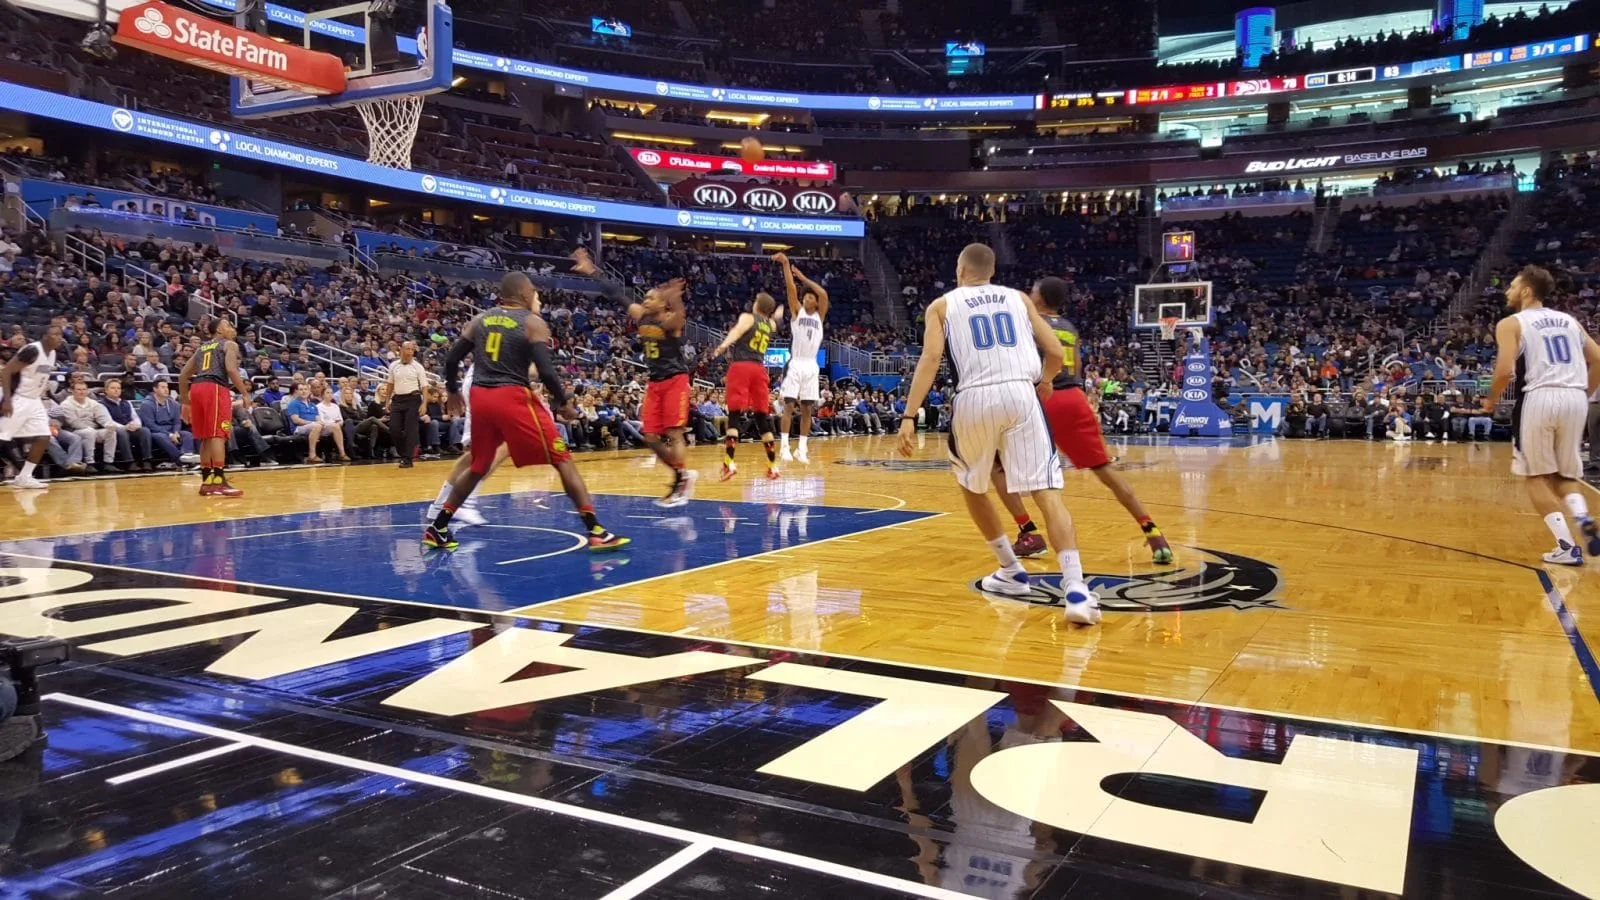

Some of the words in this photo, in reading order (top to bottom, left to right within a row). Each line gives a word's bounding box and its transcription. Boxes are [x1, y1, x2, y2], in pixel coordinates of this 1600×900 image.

[271, 9, 293, 22] LOCAL
[327, 23, 355, 37] EXPERTS
[1532, 43, 1554, 56] 3/1
[514, 64, 533, 74] LOCAL
[1206, 86, 1214, 96] 2
[137, 117, 198, 135] INTERNATIONAL
[137, 125, 174, 139] DIAMOND
[235, 140, 263, 155] LOCAL
[264, 146, 304, 163] DIAMOND
[305, 155, 338, 170] EXPERTS
[1344, 150, 1400, 164] BASELINE
[1401, 147, 1427, 159] BAR
[510, 194, 533, 205] LOCAL
[534, 198, 567, 209] DIAMOND
[567, 202, 596, 213] EXPERTS
[700, 189, 730, 205] KIA
[750, 191, 779, 207] KIA
[800, 194, 829, 210] KIA
[760, 221, 781, 229] LOCAL
[782, 222, 814, 231] DIAMOND
[815, 223, 842, 232] EXPERTS
[1180, 243, 1189, 258] 7
[964, 294, 1007, 309] GORDON
[806, 328, 814, 341] 4
[968, 310, 1018, 350] 00
[485, 331, 502, 362] 4
[1542, 335, 1571, 365] 10
[202, 351, 212, 371] 0
[1176, 410, 1209, 426] Amway
[1250, 402, 1281, 428] M
